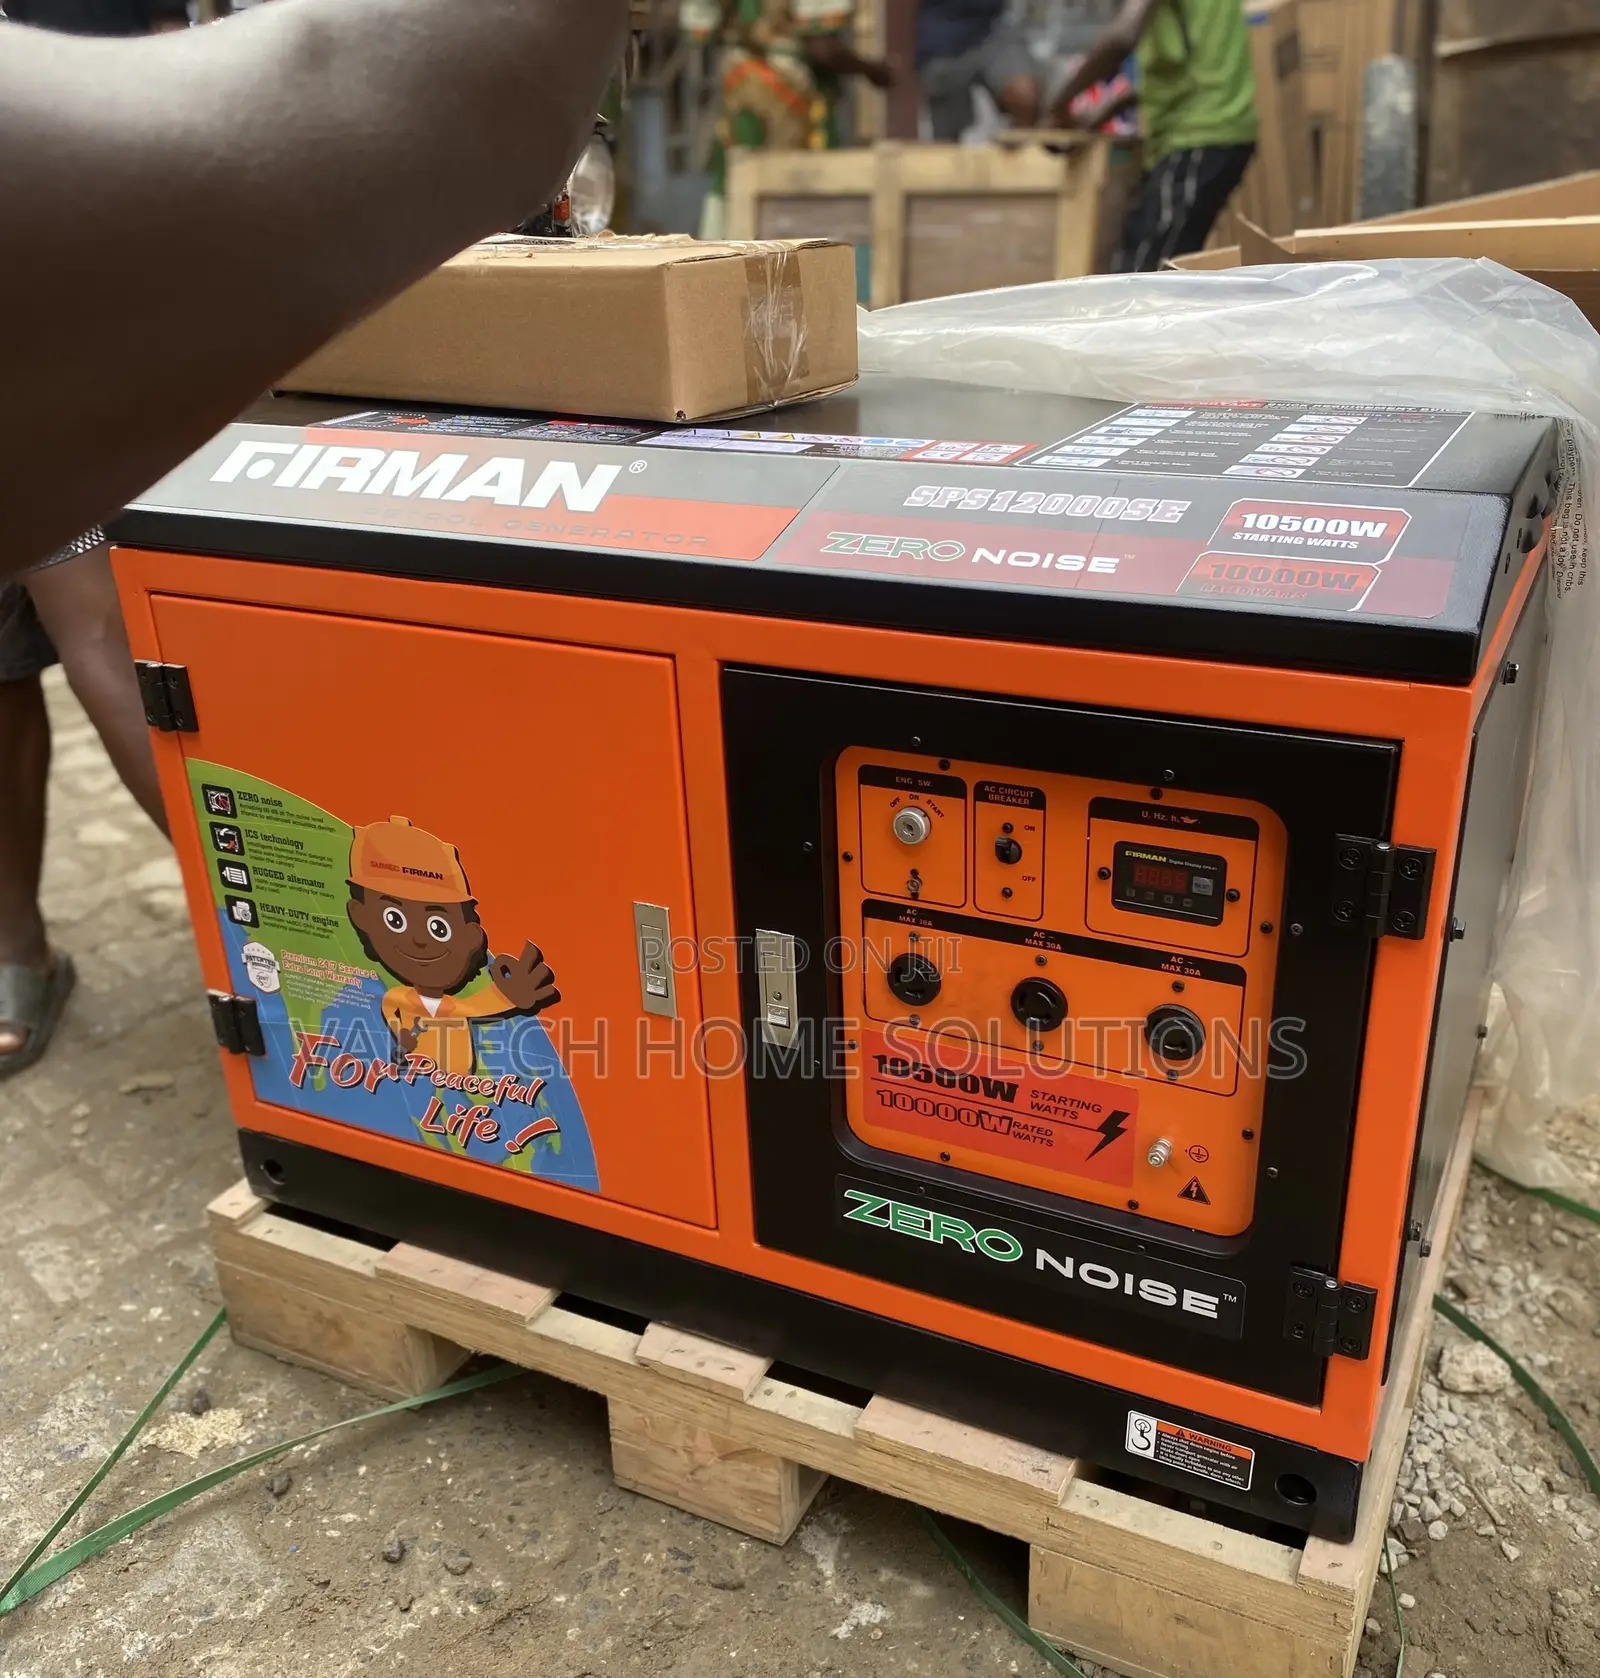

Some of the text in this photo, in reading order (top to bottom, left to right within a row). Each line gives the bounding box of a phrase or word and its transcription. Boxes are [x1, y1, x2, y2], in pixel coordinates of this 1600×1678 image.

[209, 439, 622, 512] FIRMAN
[1566, 482, 1576, 501] This
[903, 485, 1192, 524] SPS12000SE
[1561, 503, 1572, 519] bag
[504, 519, 710, 548] GENERATOR
[1240, 513, 1388, 539] 10500W
[1232, 531, 1360, 550] STARTING WATTS
[819, 531, 966, 563] ZERO
[971, 548, 1120, 574] NOISE
[1209, 563, 1361, 592] 10000W
[895, 776, 913, 785] ENG
[237, 790, 283, 808] ZERO noise
[908, 793, 919, 801] ON
[984, 785, 1036, 798] AC CIRCUIT
[988, 794, 1031, 806] BREAKER
[889, 796, 902, 808] OFF
[926, 798, 945, 820] START
[1024, 824, 1036, 832] ON
[245, 829, 304, 850] ICS technology
[1125, 850, 1167, 862] FIRMAN
[252, 866, 325, 888] RUGGED alternator
[370, 860, 443, 880] SUMEC FIRMAN
[1021, 875, 1037, 883] OFF
[259, 902, 309, 920] HEAVY-DUTY
[312, 915, 339, 927] engine
[898, 915, 916, 924] MAX
[906, 908, 917, 916] AC
[1024, 938, 1062, 951] MAX 30A
[1033, 931, 1046, 939] AC
[281, 949, 318, 966] Premium
[338, 963, 370, 978] Service
[1161, 963, 1201, 976] MAX 30A
[1170, 956, 1184, 964] AC
[282, 960, 363, 989] Extra Long Warranty
[288, 1030, 400, 1094] For
[404, 1052, 548, 1106] Peaceful
[872, 1054, 1019, 1103] 10500W
[1029, 1089, 1103, 1114] STARTING
[1030, 1100, 1080, 1120] WATTS
[876, 1088, 1014, 1136] 10000W
[1011, 1120, 1054, 1138] RATED
[1012, 1130, 1055, 1148] WATTS
[843, 1189, 1024, 1263] ZERO
[1035, 1248, 1220, 1319] NOISE
[1189, 1433, 1232, 1453] WARNING
